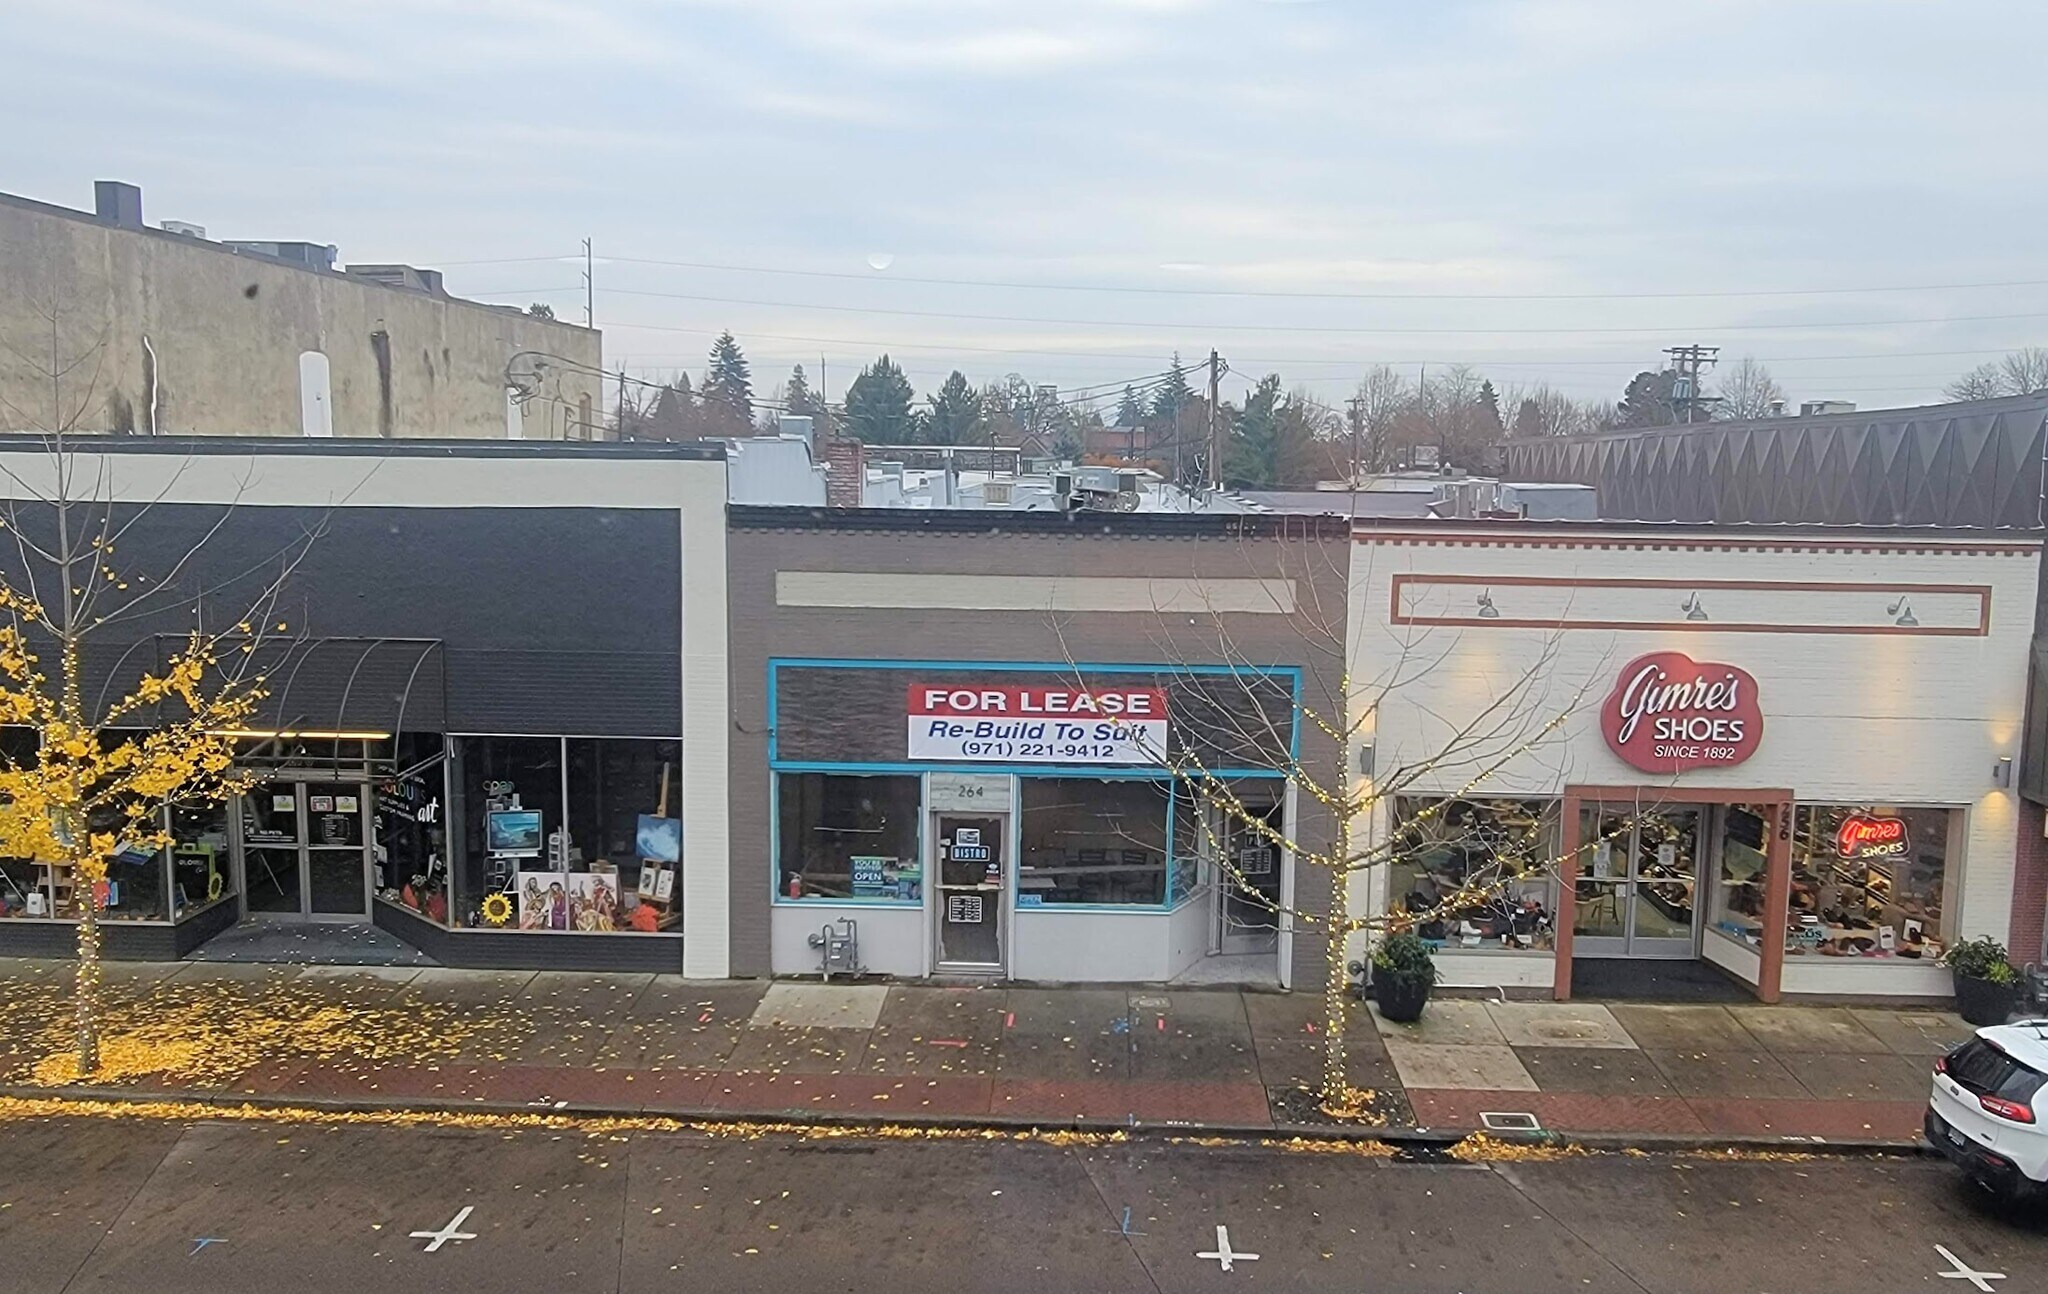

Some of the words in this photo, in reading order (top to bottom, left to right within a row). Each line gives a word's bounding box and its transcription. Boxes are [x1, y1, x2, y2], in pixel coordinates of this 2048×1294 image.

[925, 690, 1006, 711] FOR
[1020, 692, 1151, 714] LEASE
[1618, 664, 1739, 744] Gimre's
[928, 720, 1046, 740] Re-Build
[1055, 722, 1084, 741] To
[1093, 723, 1148, 742] Suit
[1653, 717, 1744, 742] SHOES
[962, 740, 1013, 757] (971)
[1020, 743, 1115, 758] 221-9412
[1653, 745, 1700, 759] SINCE
[1703, 746, 1736, 760] 1892
[958, 785, 984, 798] 264
[953, 847, 987, 859] BISTRO
[1861, 842, 1904, 858] SHOES
[854, 872, 882, 881] OPEN
